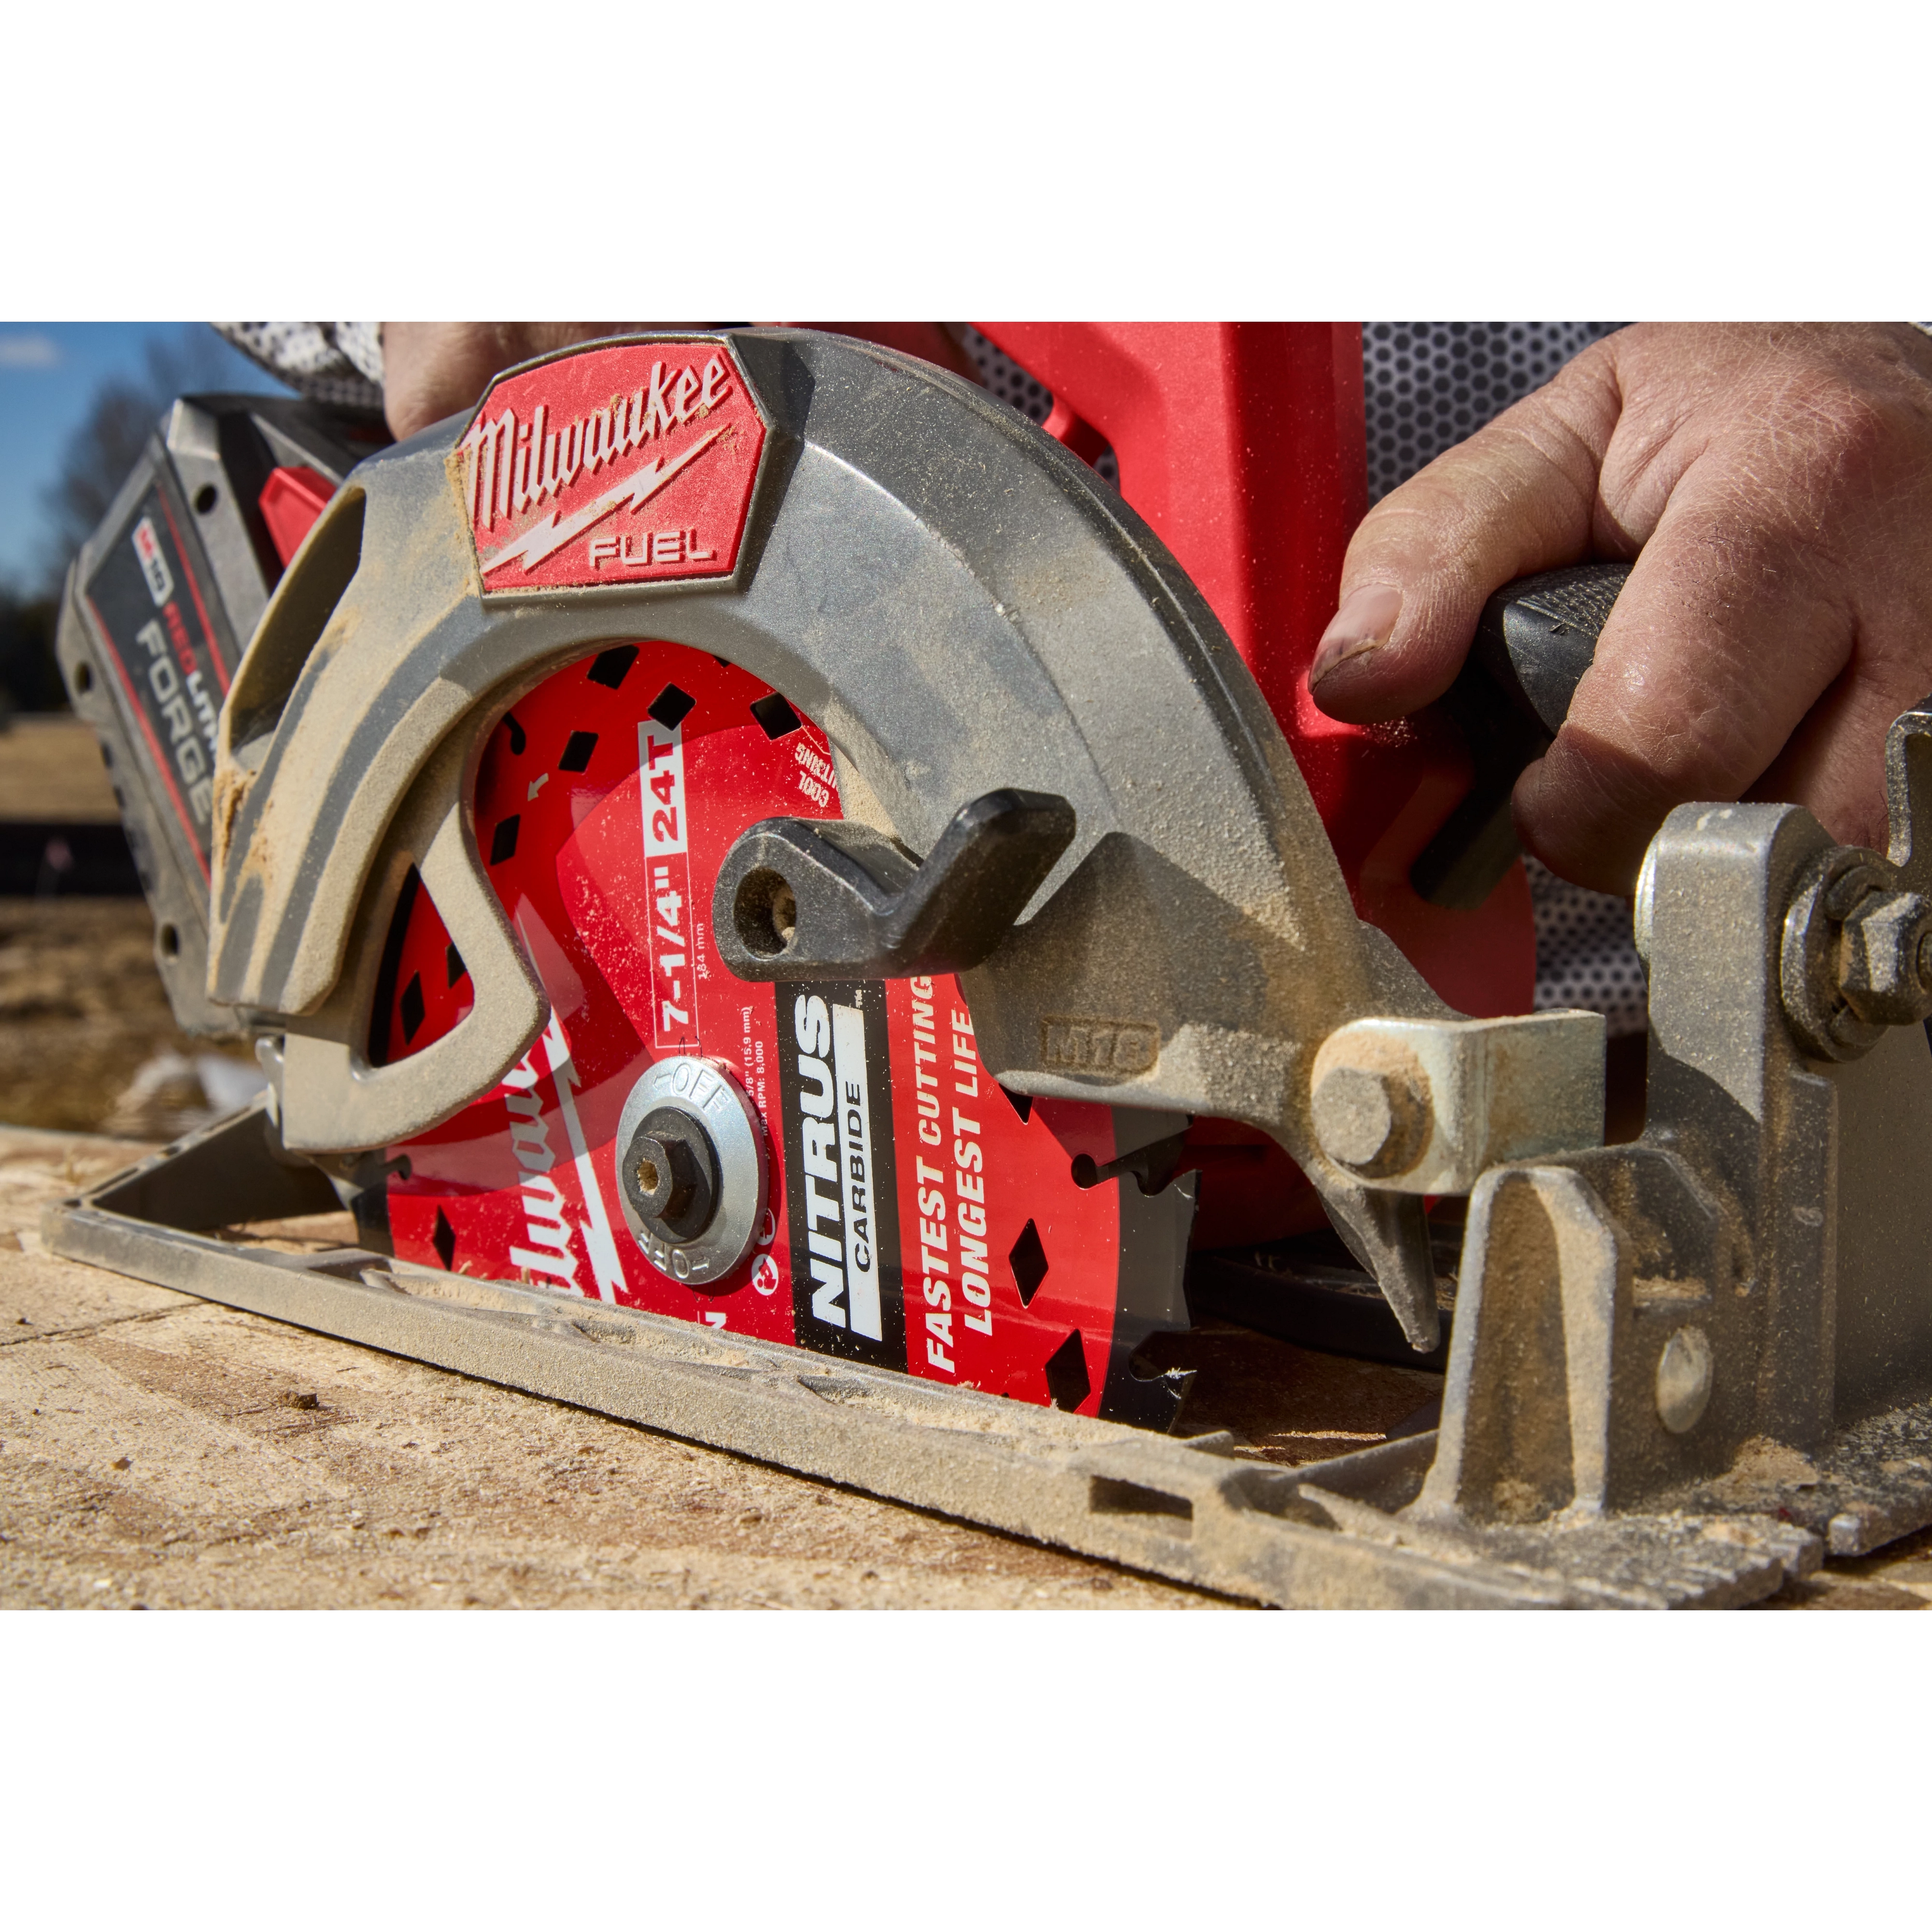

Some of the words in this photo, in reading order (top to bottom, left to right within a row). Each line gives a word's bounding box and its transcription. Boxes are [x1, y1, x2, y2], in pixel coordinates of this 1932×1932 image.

[459, 354, 732, 530] Milwaukee
[590, 530, 715, 568] FUEL
[136, 620, 214, 826] FORGE
[646, 735, 679, 842] 24T
[798, 770, 829, 808] COOL
[654, 867, 690, 1032] 7-1/4"
[672, 1061, 729, 1112] OFF
[755, 1040, 766, 1074] 8,000
[909, 976, 943, 1146] CUTTING
[952, 1009, 980, 1098] LIFE
[795, 994, 846, 1328] NITRUS
[845, 1082, 871, 1273] CARBIDE
[952, 1108, 993, 1337] LONGEST
[638, 1232, 690, 1279] OFF
[916, 1156, 955, 1374] FASTEST
